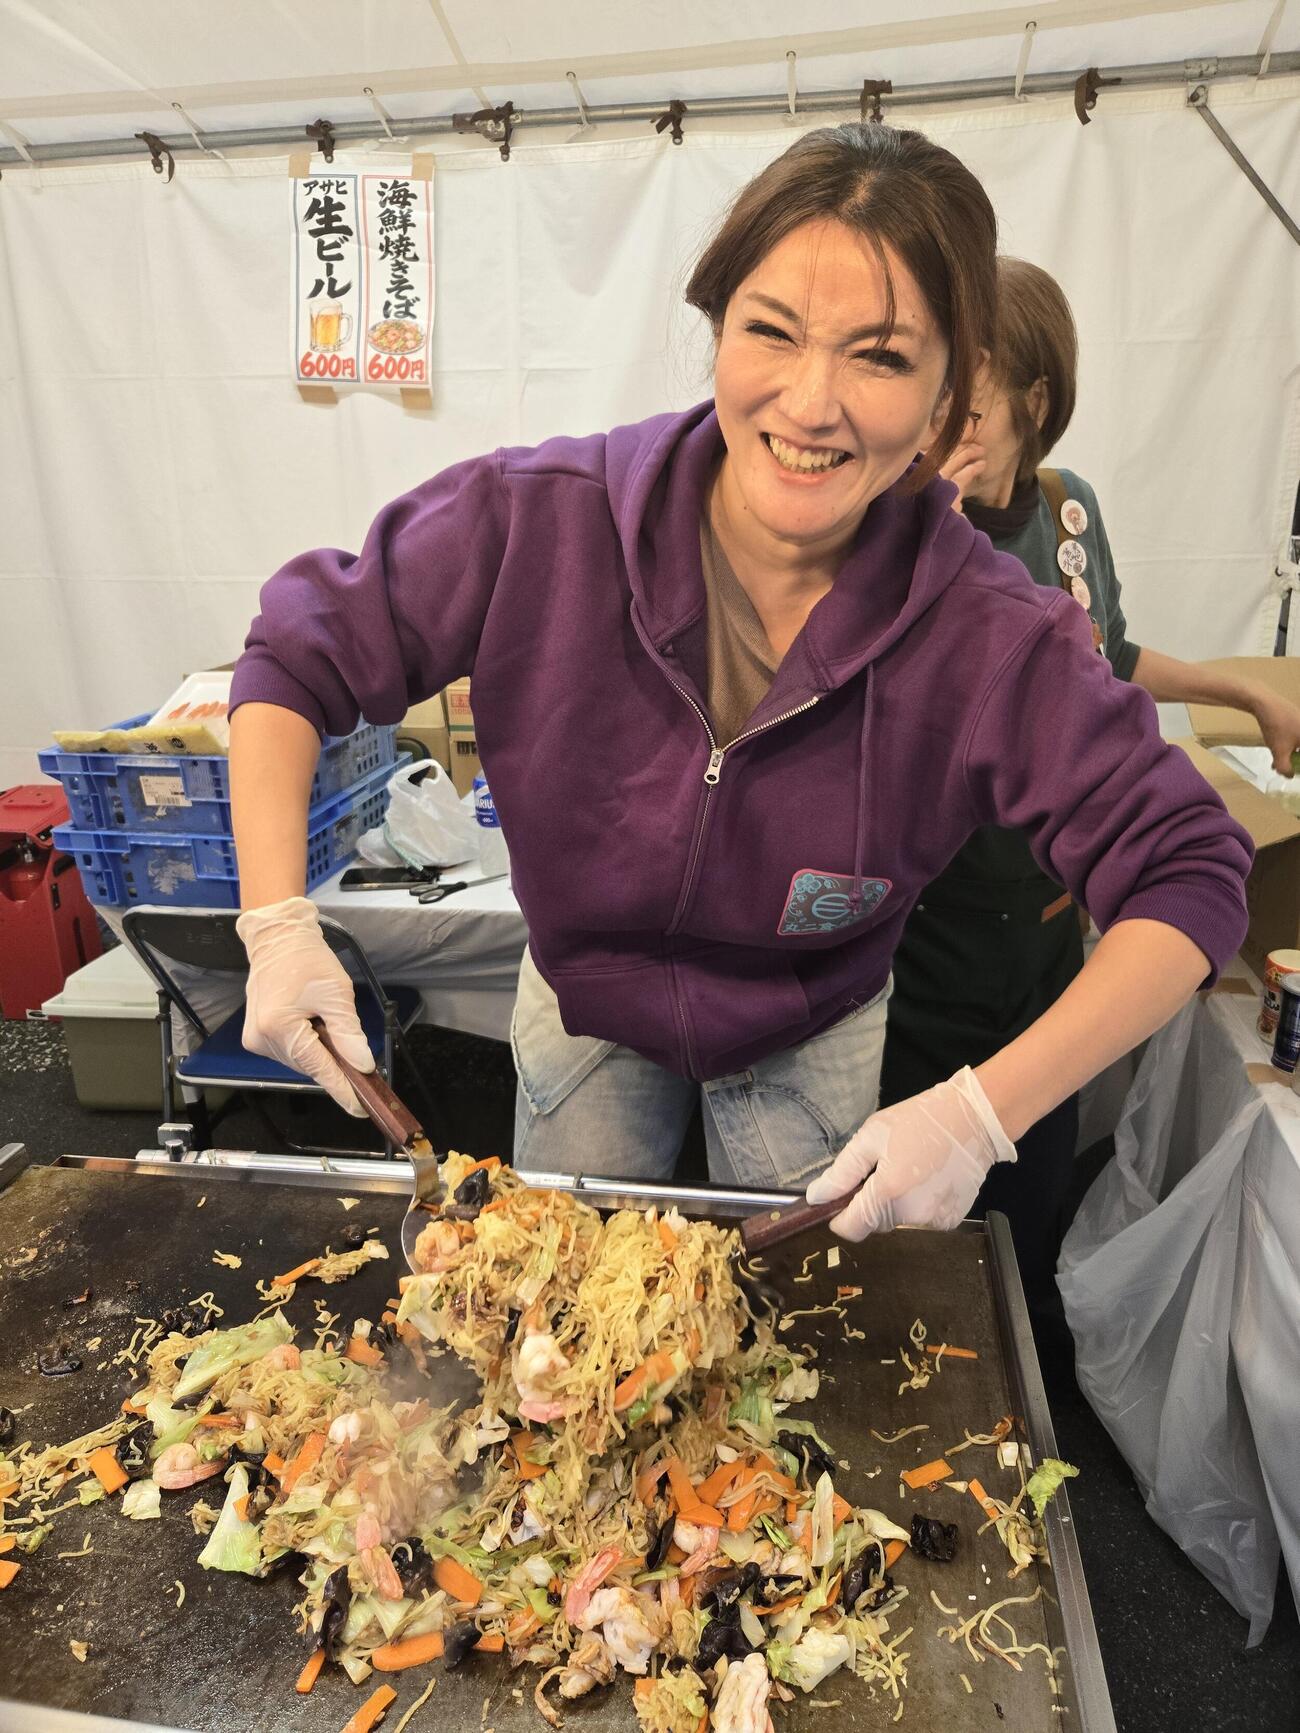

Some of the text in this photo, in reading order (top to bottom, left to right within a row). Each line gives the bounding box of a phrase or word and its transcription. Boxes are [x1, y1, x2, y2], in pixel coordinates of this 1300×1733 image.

[303, 179, 348, 196] アサヒ
[303, 195, 354, 300] 生ビール
[376, 179, 421, 320] 海鮮焼きそば
[300, 351, 355, 379] 600円
[368, 353, 425, 381] 600円
